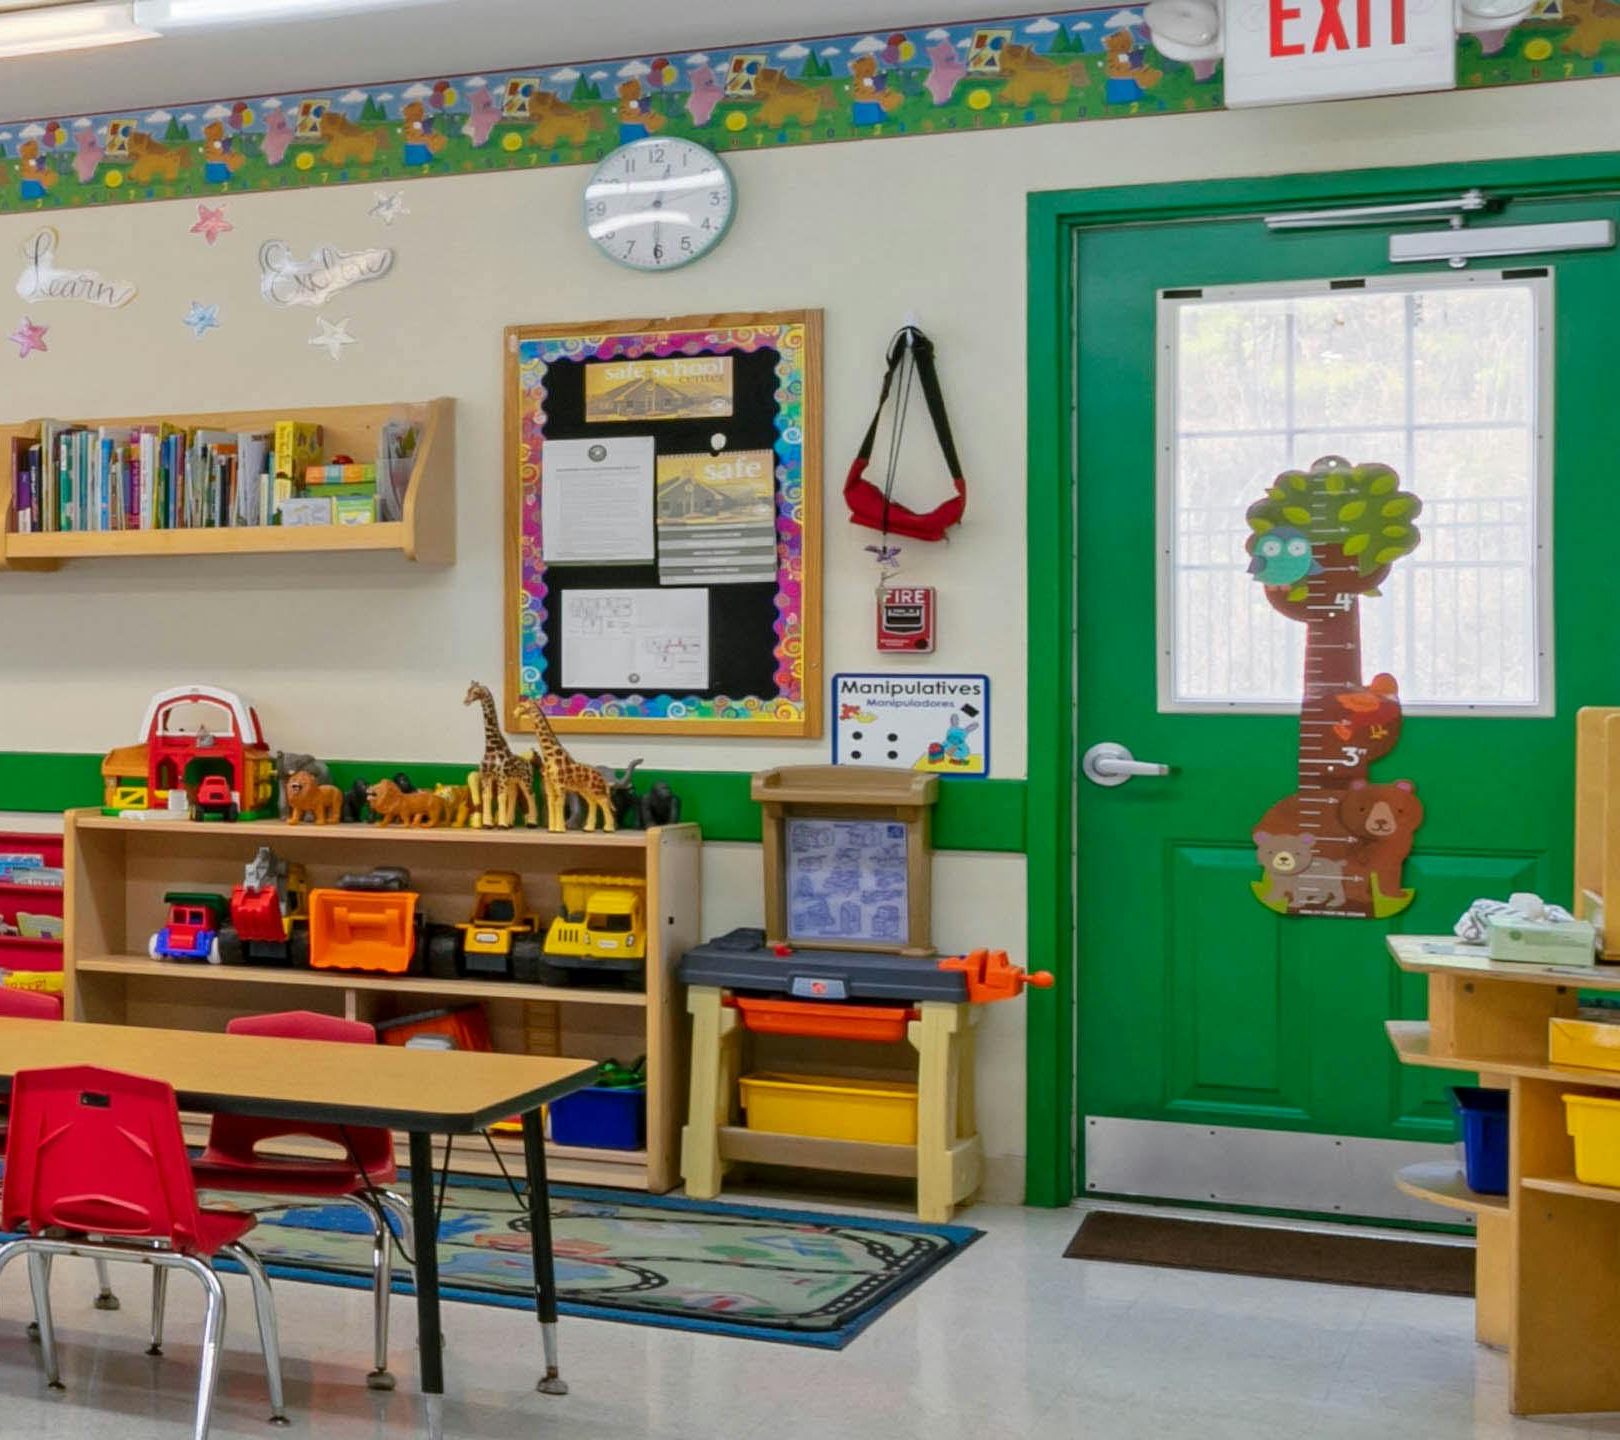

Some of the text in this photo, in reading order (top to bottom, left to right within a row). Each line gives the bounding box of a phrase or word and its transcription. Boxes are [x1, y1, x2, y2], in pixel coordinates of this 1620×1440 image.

[648, 149, 665, 164] 12
[709, 191, 721, 206] 3
[596, 201, 607, 216] 9
[700, 217, 711, 231] 4
[626, 240, 636, 255] 7
[681, 235, 692, 251] 5
[23, 232, 134, 304] Learn
[604, 358, 724, 381] safe school
[703, 456, 762, 481] safe
[883, 590, 925, 604] FIRE
[841, 680, 982, 698] Manipulatives
[866, 698, 955, 709] Manipuladores
